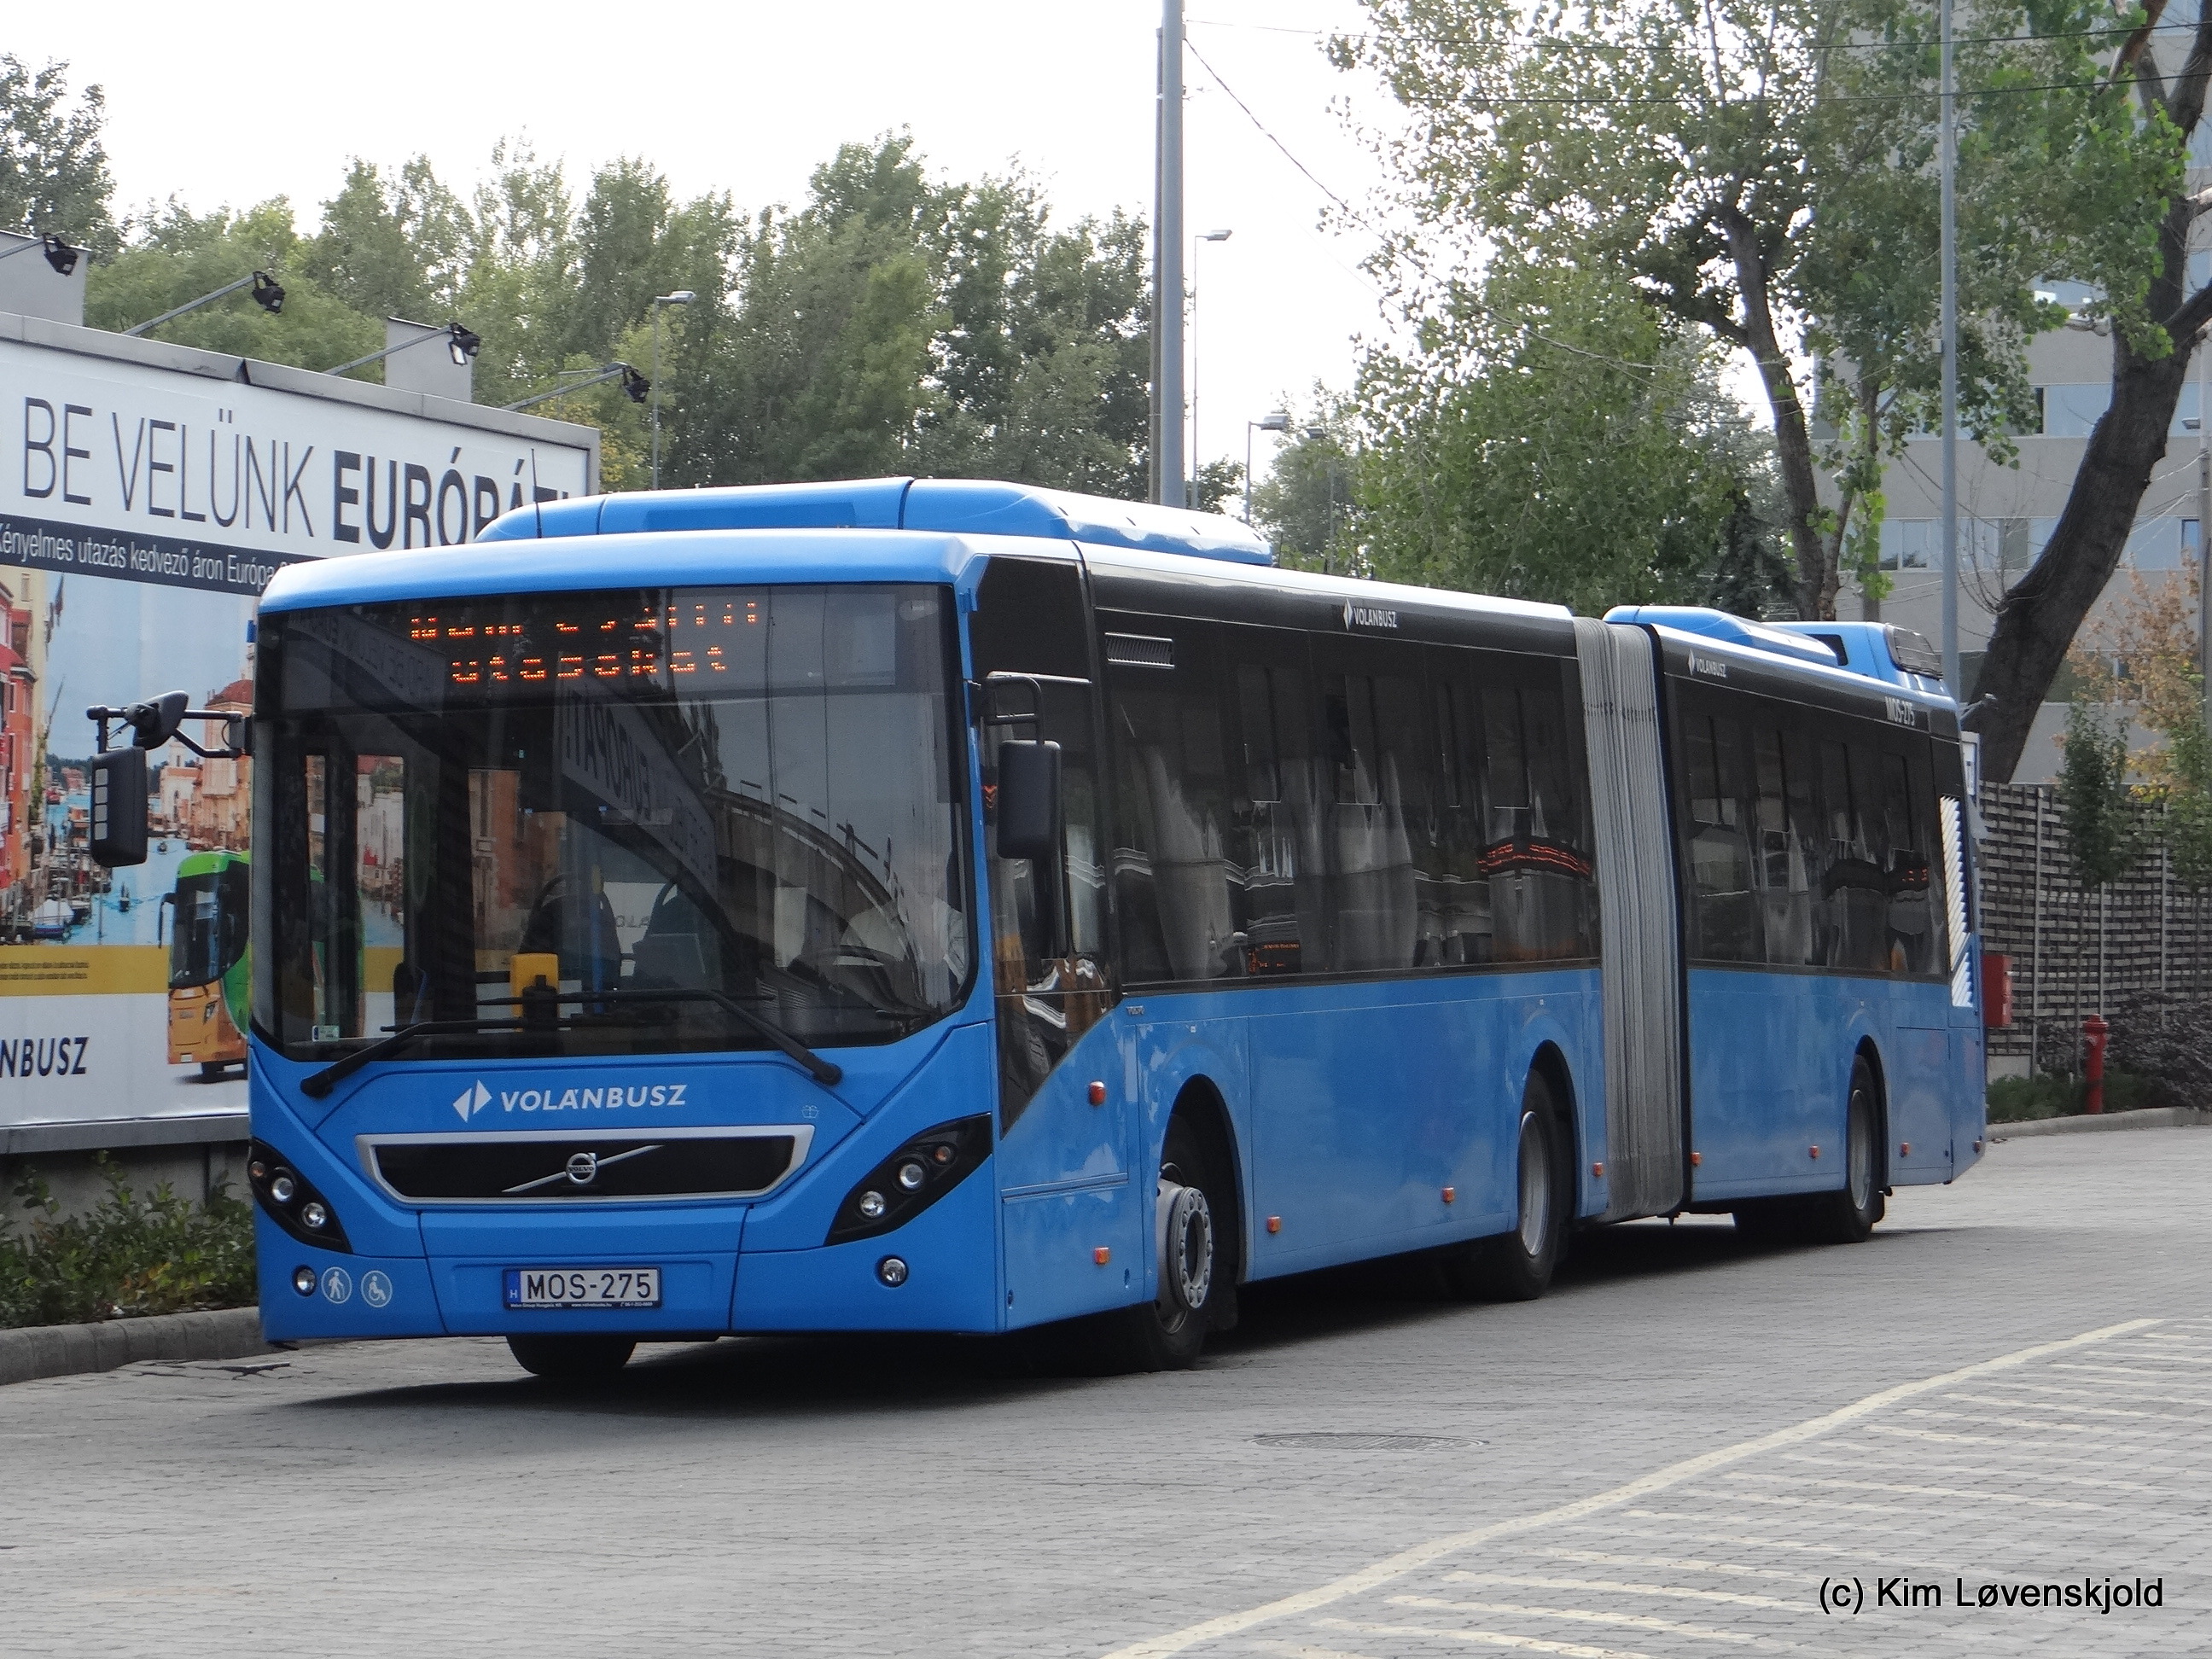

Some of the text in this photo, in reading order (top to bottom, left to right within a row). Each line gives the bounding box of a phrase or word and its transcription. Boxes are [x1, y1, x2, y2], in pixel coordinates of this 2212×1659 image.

[23, 396, 93, 506] BE
[112, 409, 315, 538] VELÜNK
[78, 538, 127, 569] utazás
[131, 540, 189, 577] kedvező
[192, 549, 224, 582] áron
[509, 1272, 652, 1301] H MOS-275
